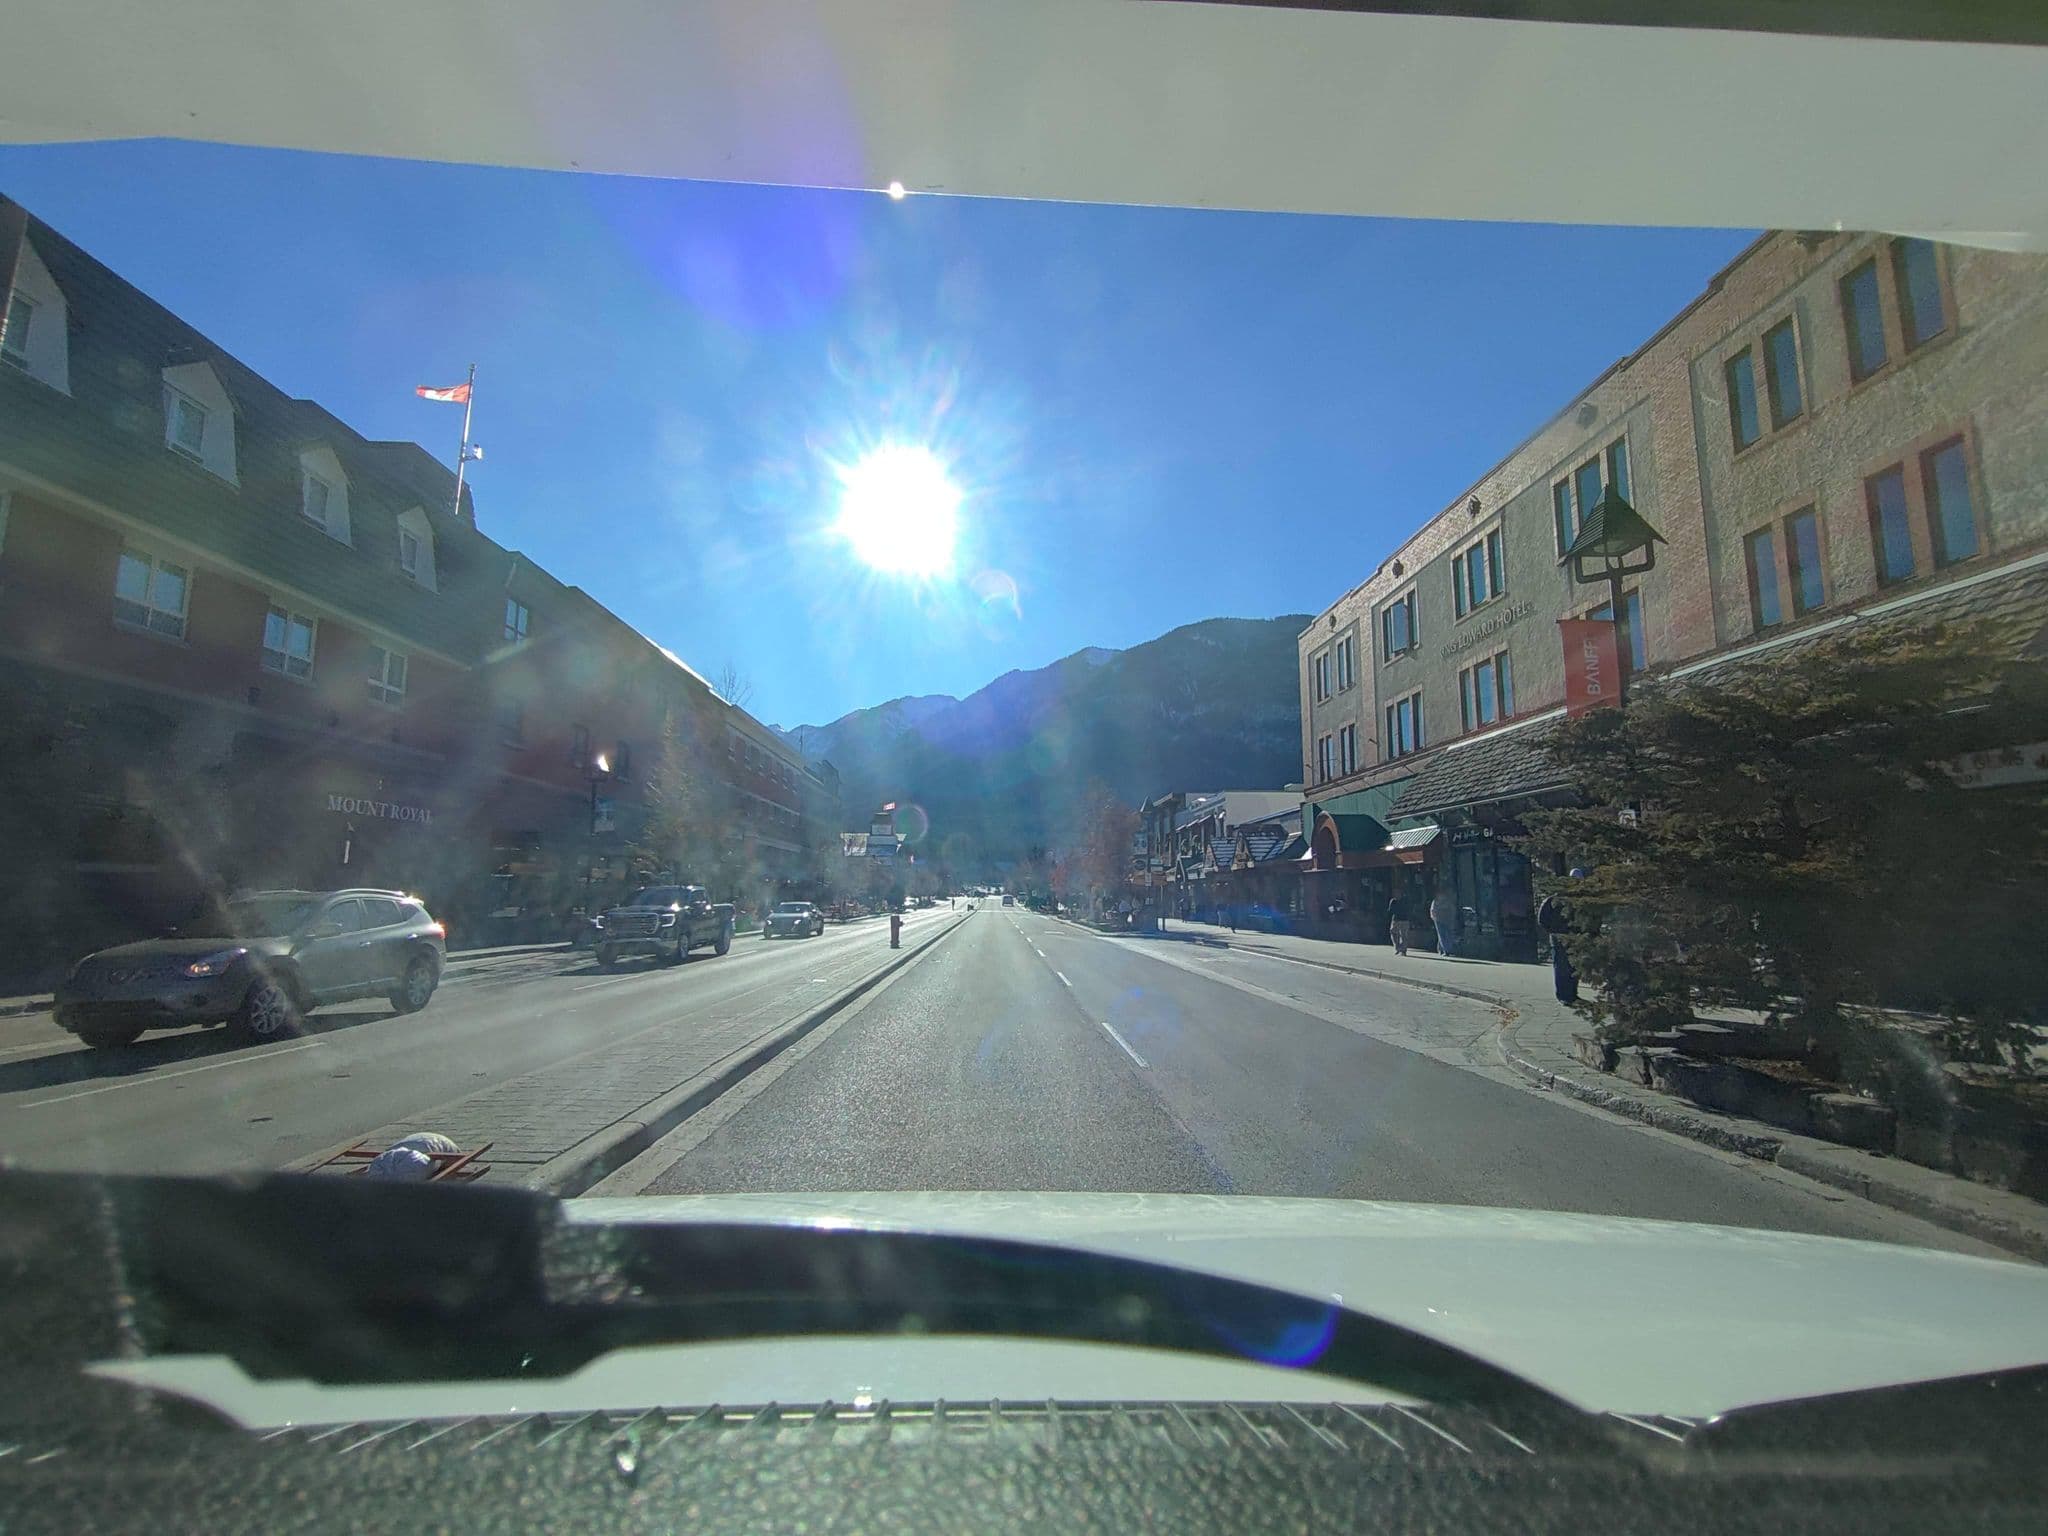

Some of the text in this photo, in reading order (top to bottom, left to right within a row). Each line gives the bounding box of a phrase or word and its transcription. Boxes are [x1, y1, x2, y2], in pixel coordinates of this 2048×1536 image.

[1459, 619, 1495, 648] EDWARD
[1496, 600, 1528, 628] HOTEL
[1583, 639, 1601, 695] BANFF
[327, 794, 432, 824] MOUNT ROYAL
